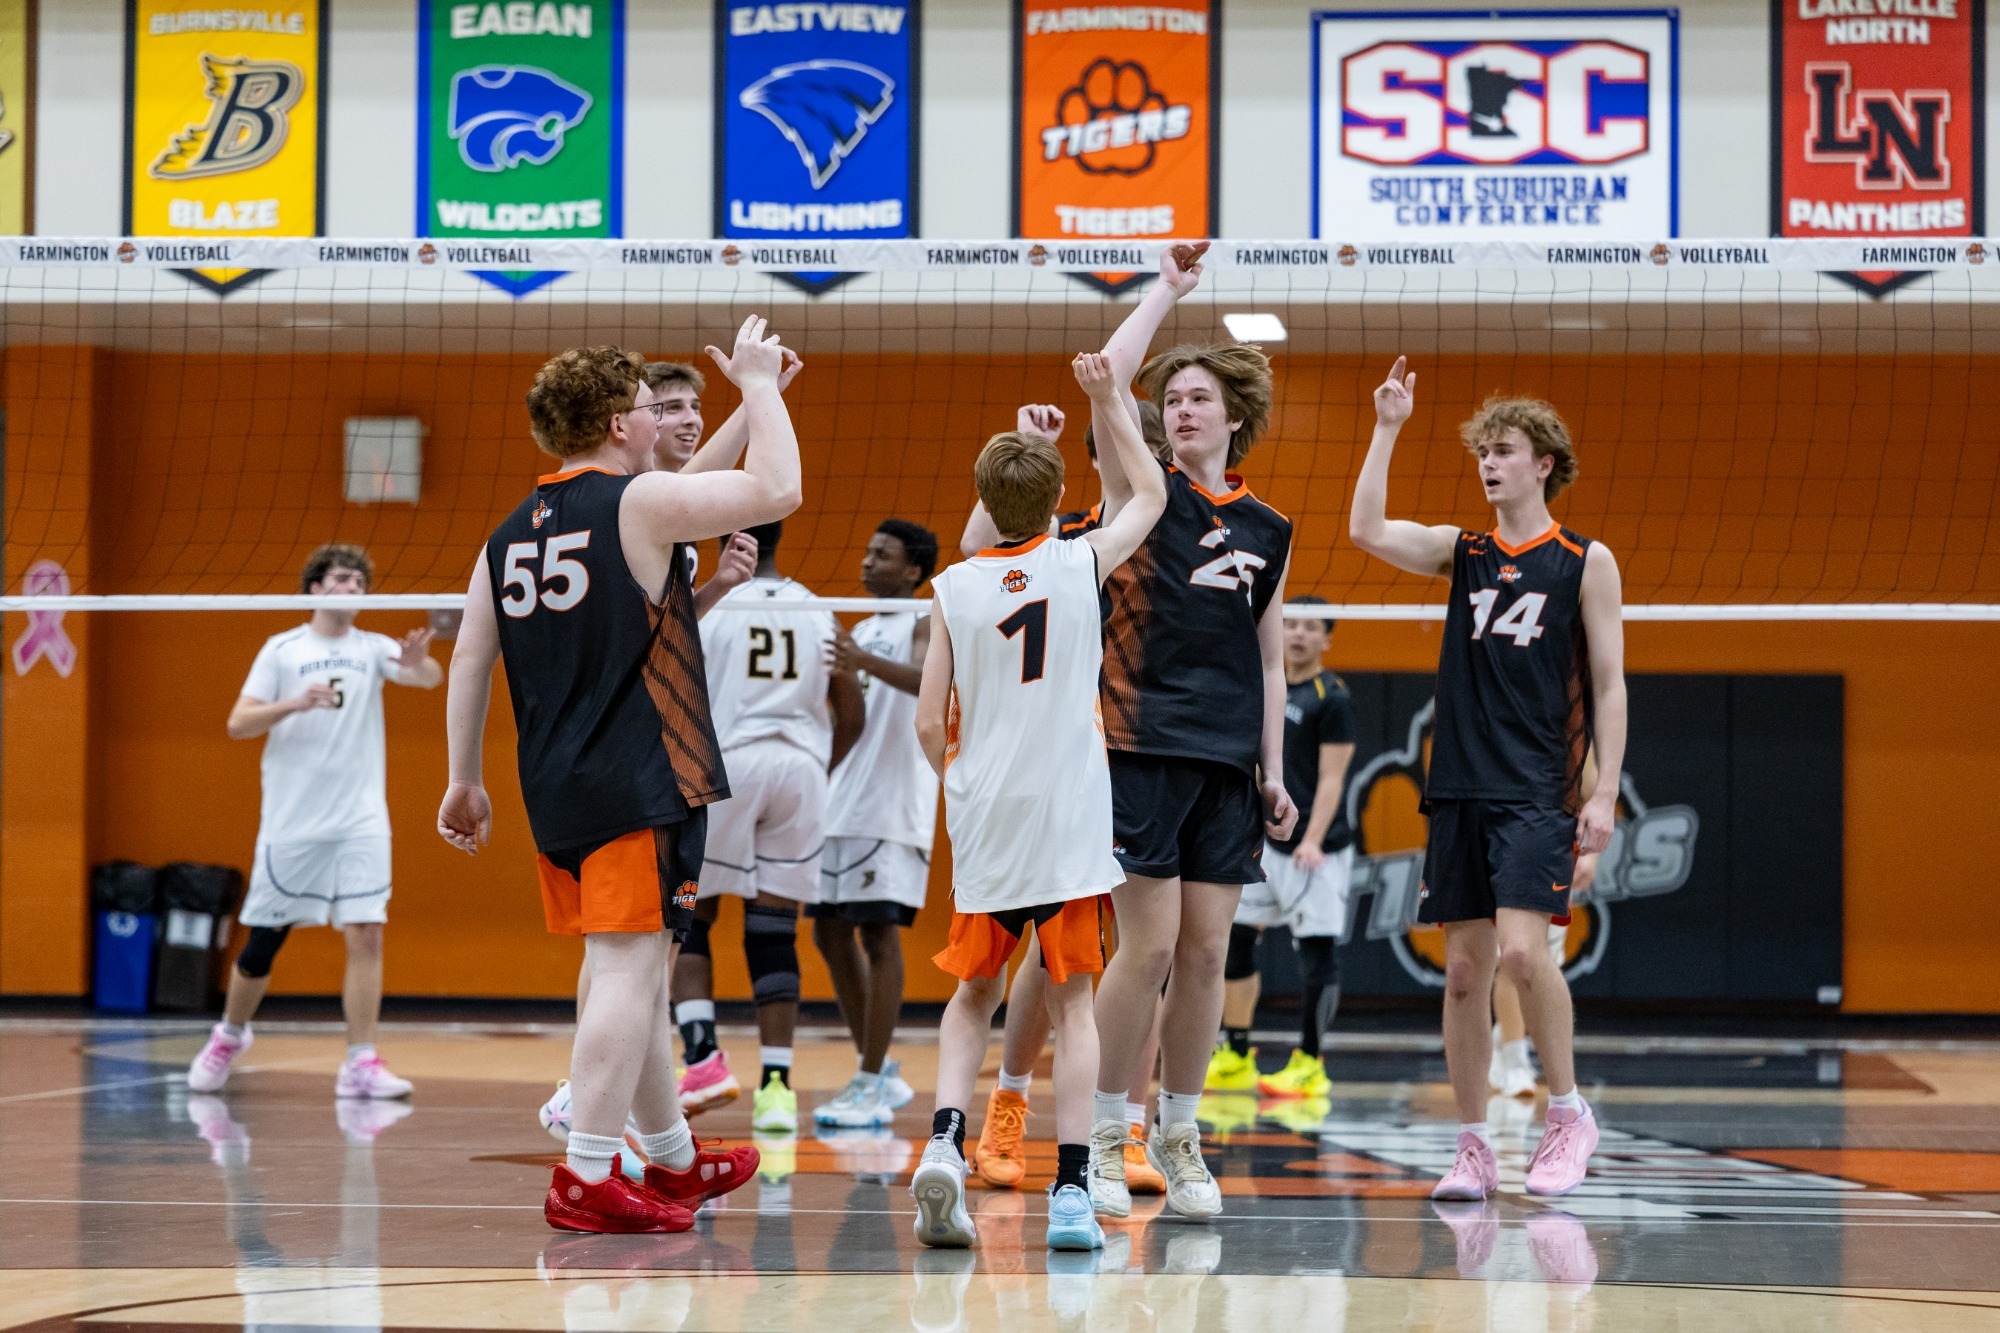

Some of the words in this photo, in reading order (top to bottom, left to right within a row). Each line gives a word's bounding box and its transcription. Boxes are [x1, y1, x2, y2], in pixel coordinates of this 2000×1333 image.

[149, 12, 304, 35] BURNSVILLE
[451, 4, 592, 38] EAGAN
[731, 4, 905, 36] EASTVIEW
[1027, 9, 1208, 35] FARMINGTON
[1826, 20, 1930, 45] NORTH
[1341, 39, 1649, 167] SSC
[1041, 105, 1191, 160] TIGERS
[1804, 61, 1950, 190] LN
[1370, 177, 1466, 203] SOUTH
[1475, 176, 1628, 202] SUBURBAN
[169, 200, 279, 230] BLAZE
[437, 200, 602, 231] WILDCATS
[731, 200, 902, 231] LIGHTNING
[1056, 206, 1174, 236] TIGERS
[1396, 204, 1602, 226] CONFERENCE
[1789, 198, 1965, 231] PANTHERS
[19, 245, 108, 262] FARMINGTON
[146, 245, 231, 262] VOLLEYBALL
[319, 246, 409, 262] FARMINGTON
[447, 246, 532, 264] VOLLEYBALL
[622, 248, 712, 264] FARMINGTON
[751, 248, 837, 265] VOLLEYBALL
[927, 249, 1019, 264] FARMINGTON
[1058, 249, 1144, 265] VOLLEYBALL
[1236, 249, 1328, 265] FARMINGTON
[1367, 248, 1454, 265] VOLLEYBALL
[1547, 247, 1641, 264] FARMINGTON
[1680, 248, 1769, 264] VOLLEYBALL
[1862, 247, 1956, 263] FARMINGTON
[501, 530, 592, 618] 55
[1189, 528, 1267, 608] 25
[1469, 588, 1548, 647] 14
[747, 627, 798, 680] 21
[996, 598, 1049, 684] 1
